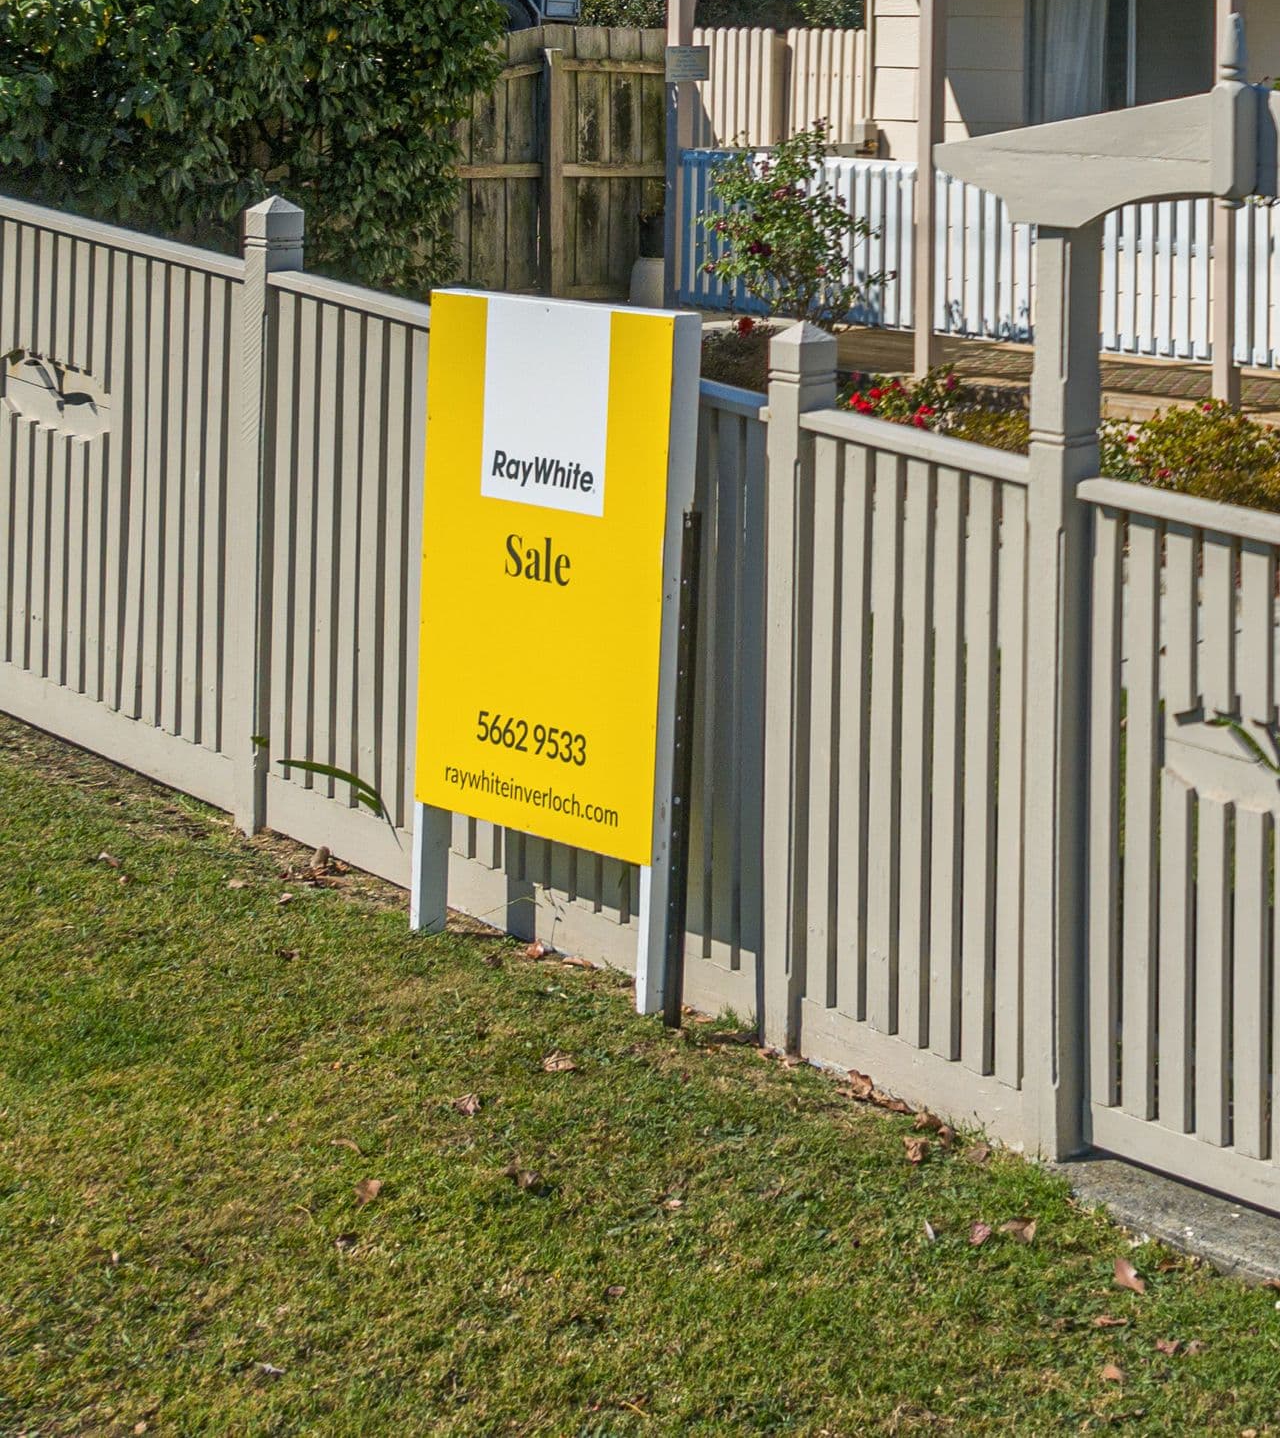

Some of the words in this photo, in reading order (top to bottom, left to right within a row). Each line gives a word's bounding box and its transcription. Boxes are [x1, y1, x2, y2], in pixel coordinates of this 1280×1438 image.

[504, 534, 571, 587] Sale
[476, 710, 529, 753] 5662
[533, 724, 586, 766] 9533
[445, 765, 618, 828] raywhiteinverloch.com
